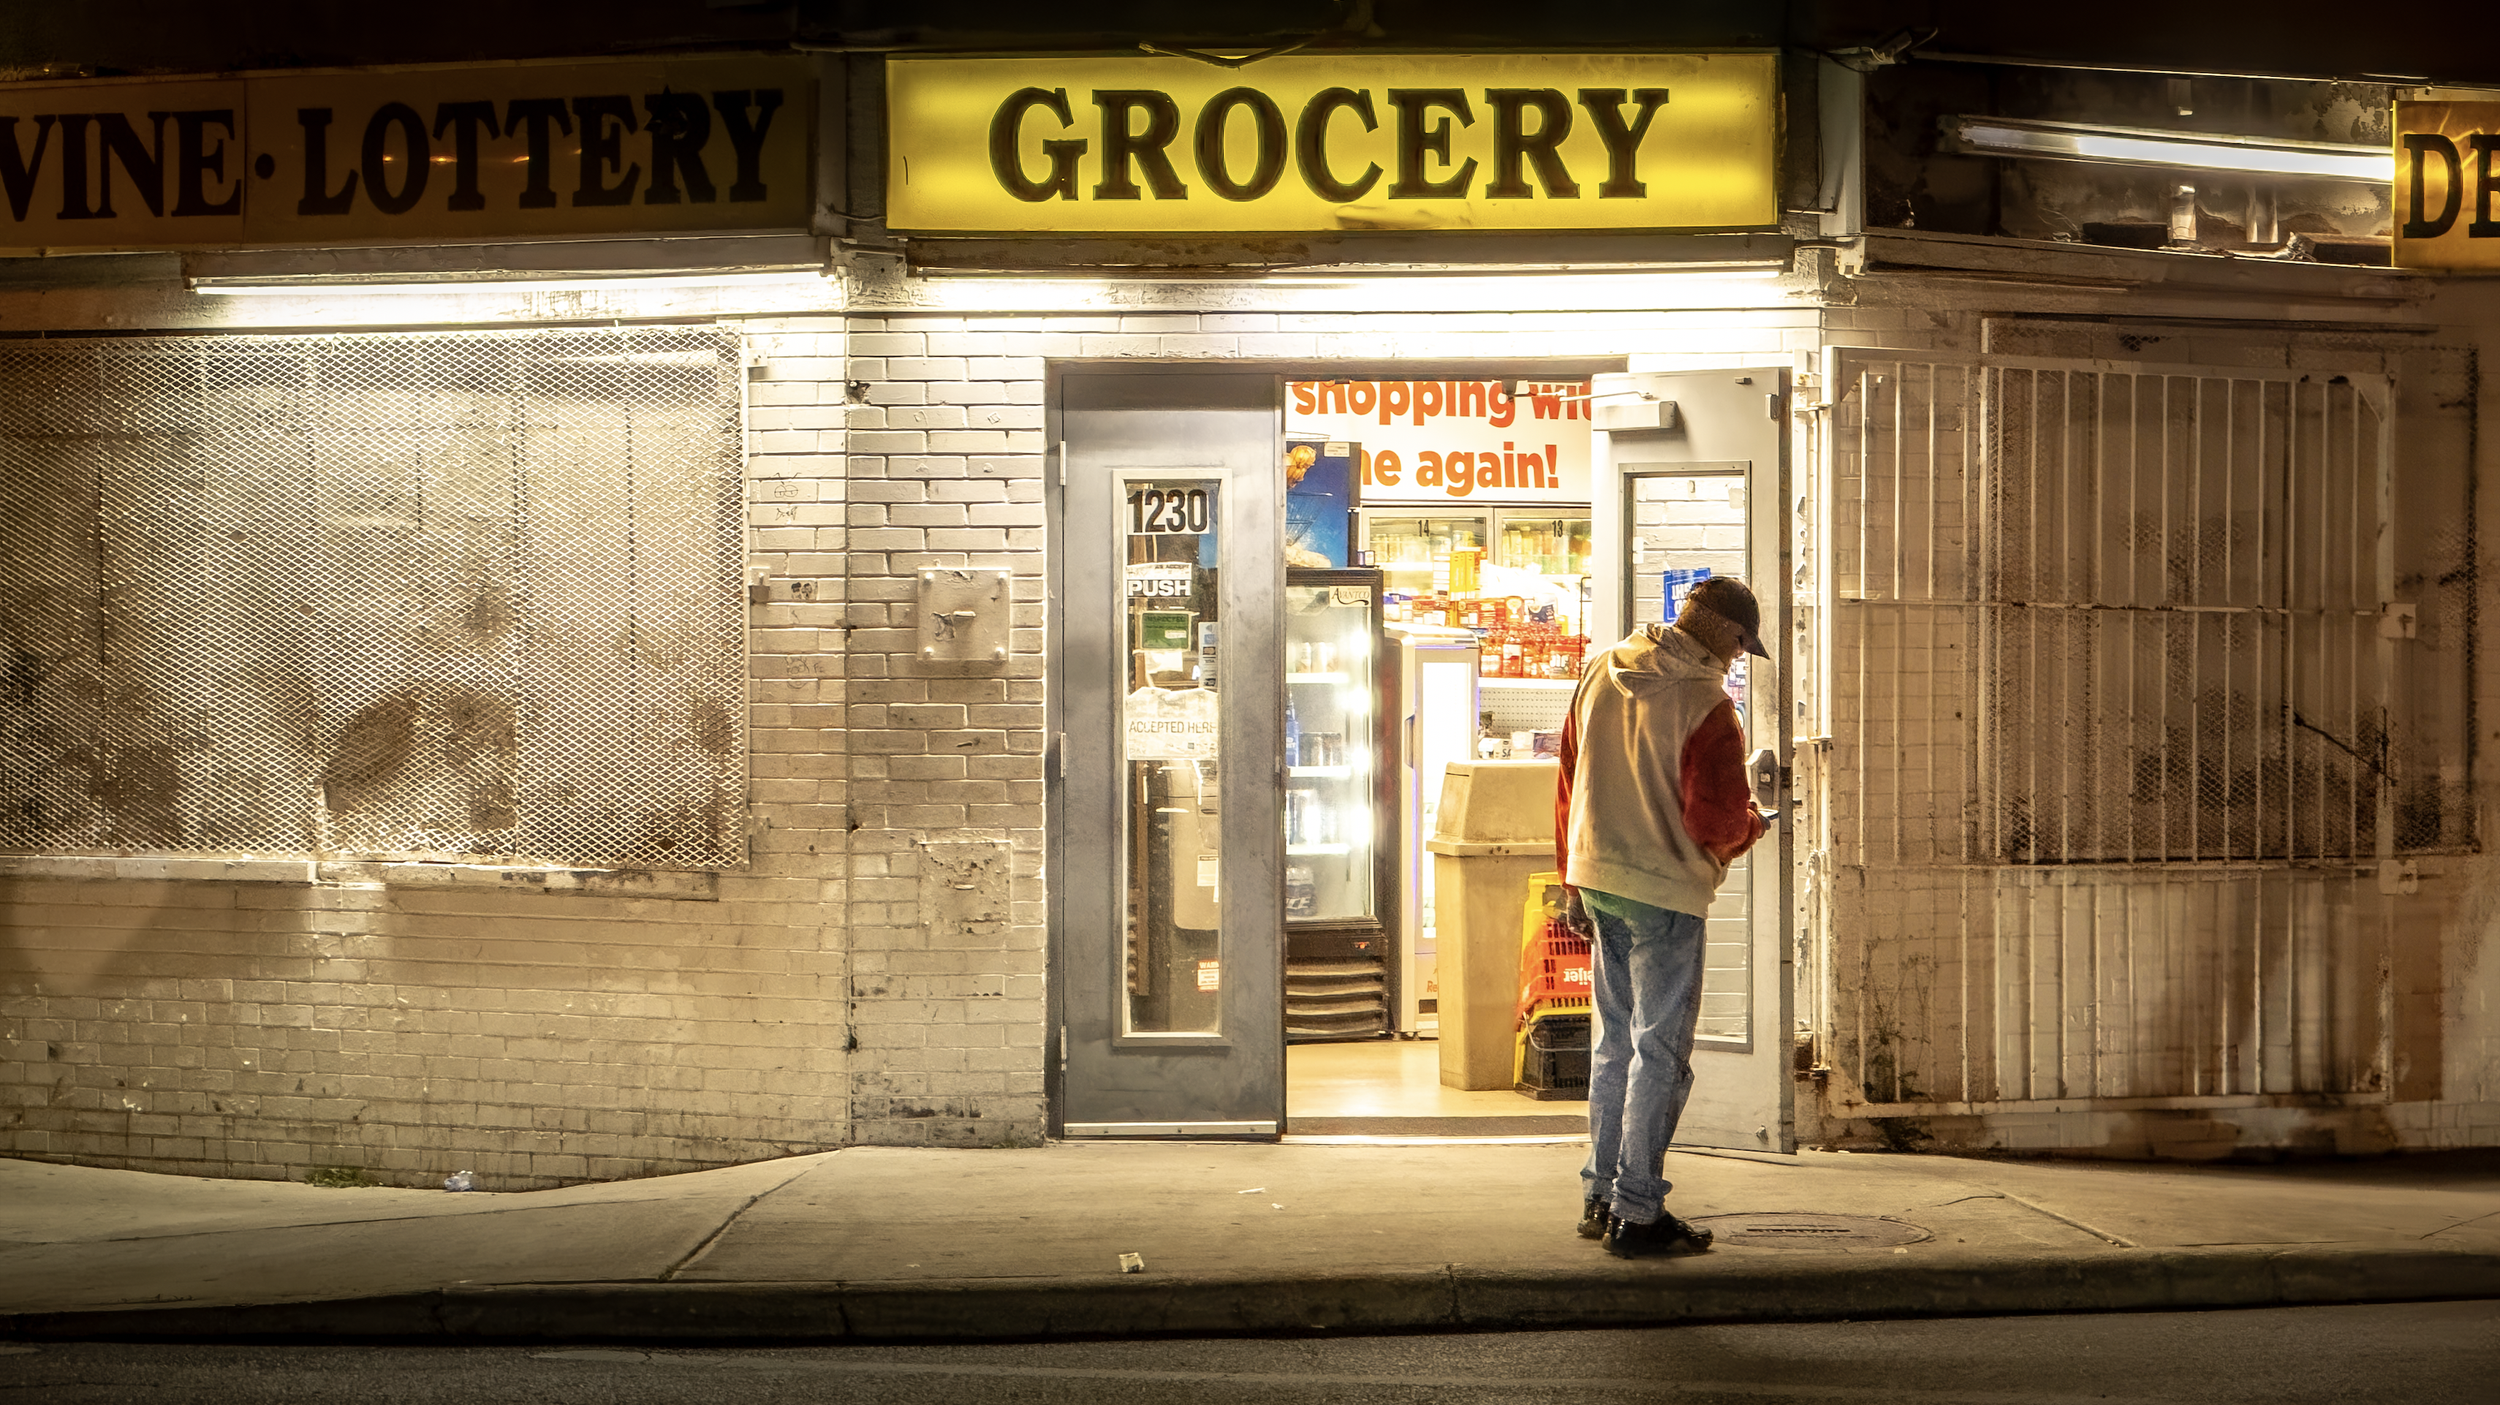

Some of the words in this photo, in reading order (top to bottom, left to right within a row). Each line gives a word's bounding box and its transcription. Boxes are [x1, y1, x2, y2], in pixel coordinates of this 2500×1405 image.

[297, 88, 784, 216] LOTTERY
[989, 87, 1670, 203] GROCERY
[2403, 133, 2500, 239] DE
[1292, 381, 1516, 428] shopping
[1415, 442, 1559, 497] again!
[1127, 489, 1208, 533] 1230
[1418, 519, 1430, 538] 14
[1552, 519, 1564, 538] 13
[1128, 580, 1192, 597] PUSH
[1331, 587, 1371, 602] AVANTCO
[1129, 721, 1185, 734] ACCEPTED
